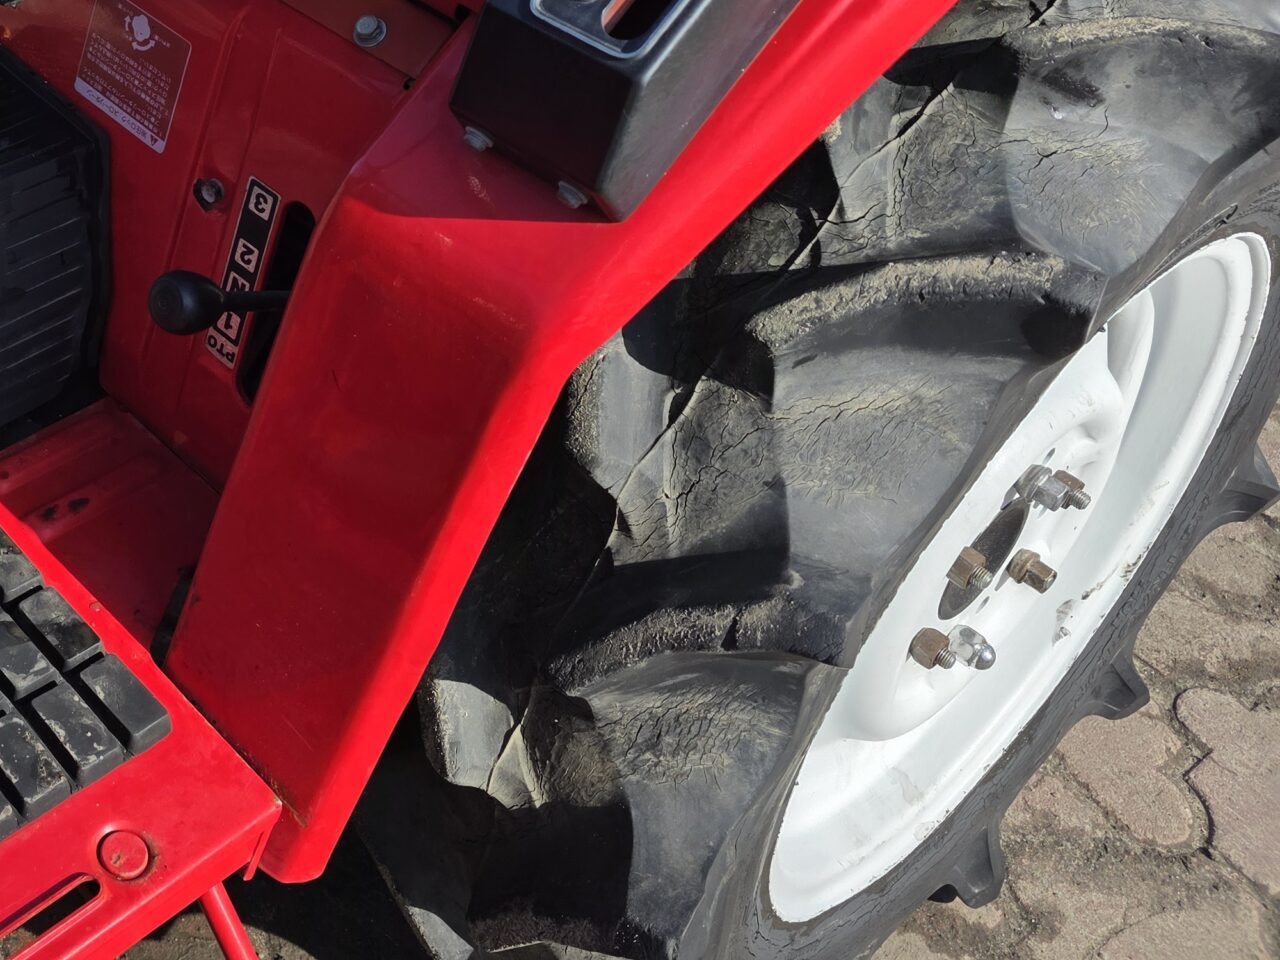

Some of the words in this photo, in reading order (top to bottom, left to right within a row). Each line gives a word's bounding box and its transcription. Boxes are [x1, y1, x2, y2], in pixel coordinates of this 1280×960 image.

[253, 192, 268, 214] 3
[239, 244, 255, 261] 2
[223, 312, 233, 330] 1
[207, 334, 236, 364] PTO
